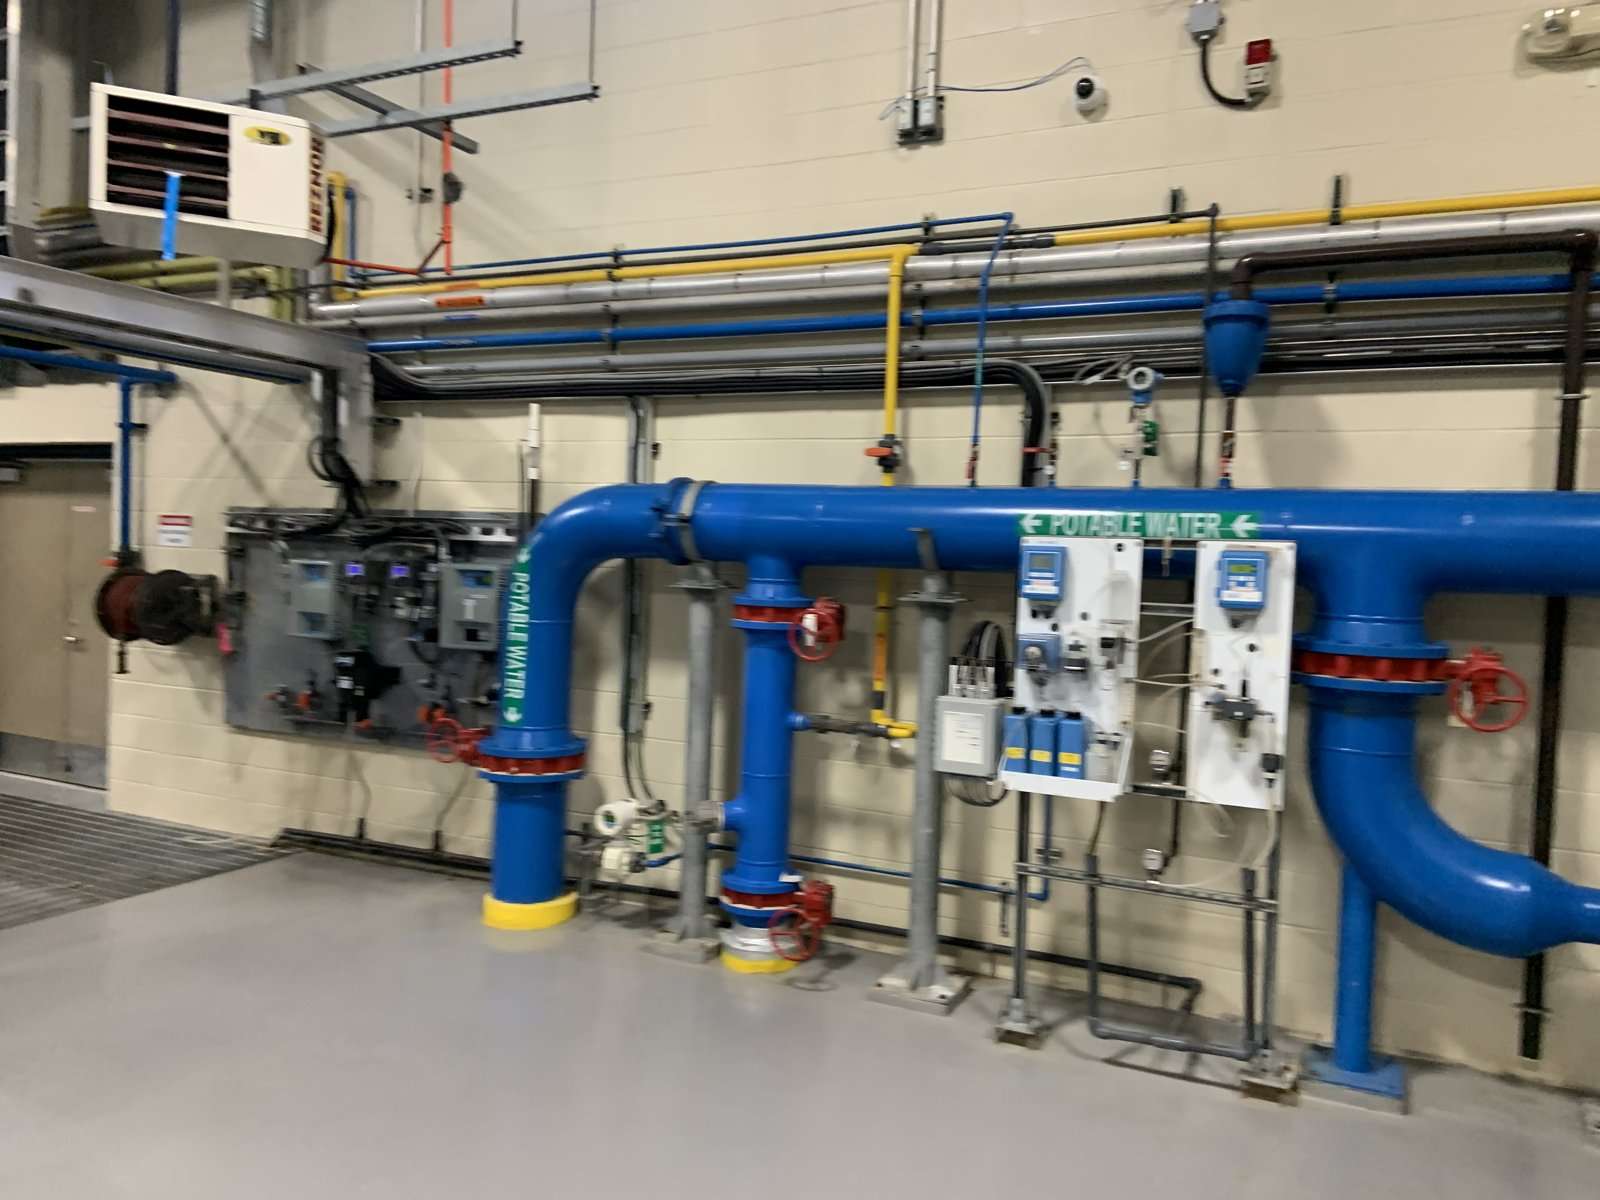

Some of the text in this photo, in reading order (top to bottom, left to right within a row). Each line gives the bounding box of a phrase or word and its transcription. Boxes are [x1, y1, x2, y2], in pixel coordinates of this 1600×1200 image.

[310, 136, 323, 233] REZNOR
[1051, 513, 1221, 538] POTABLE WATER
[504, 572, 530, 699] POTABLE WATER
